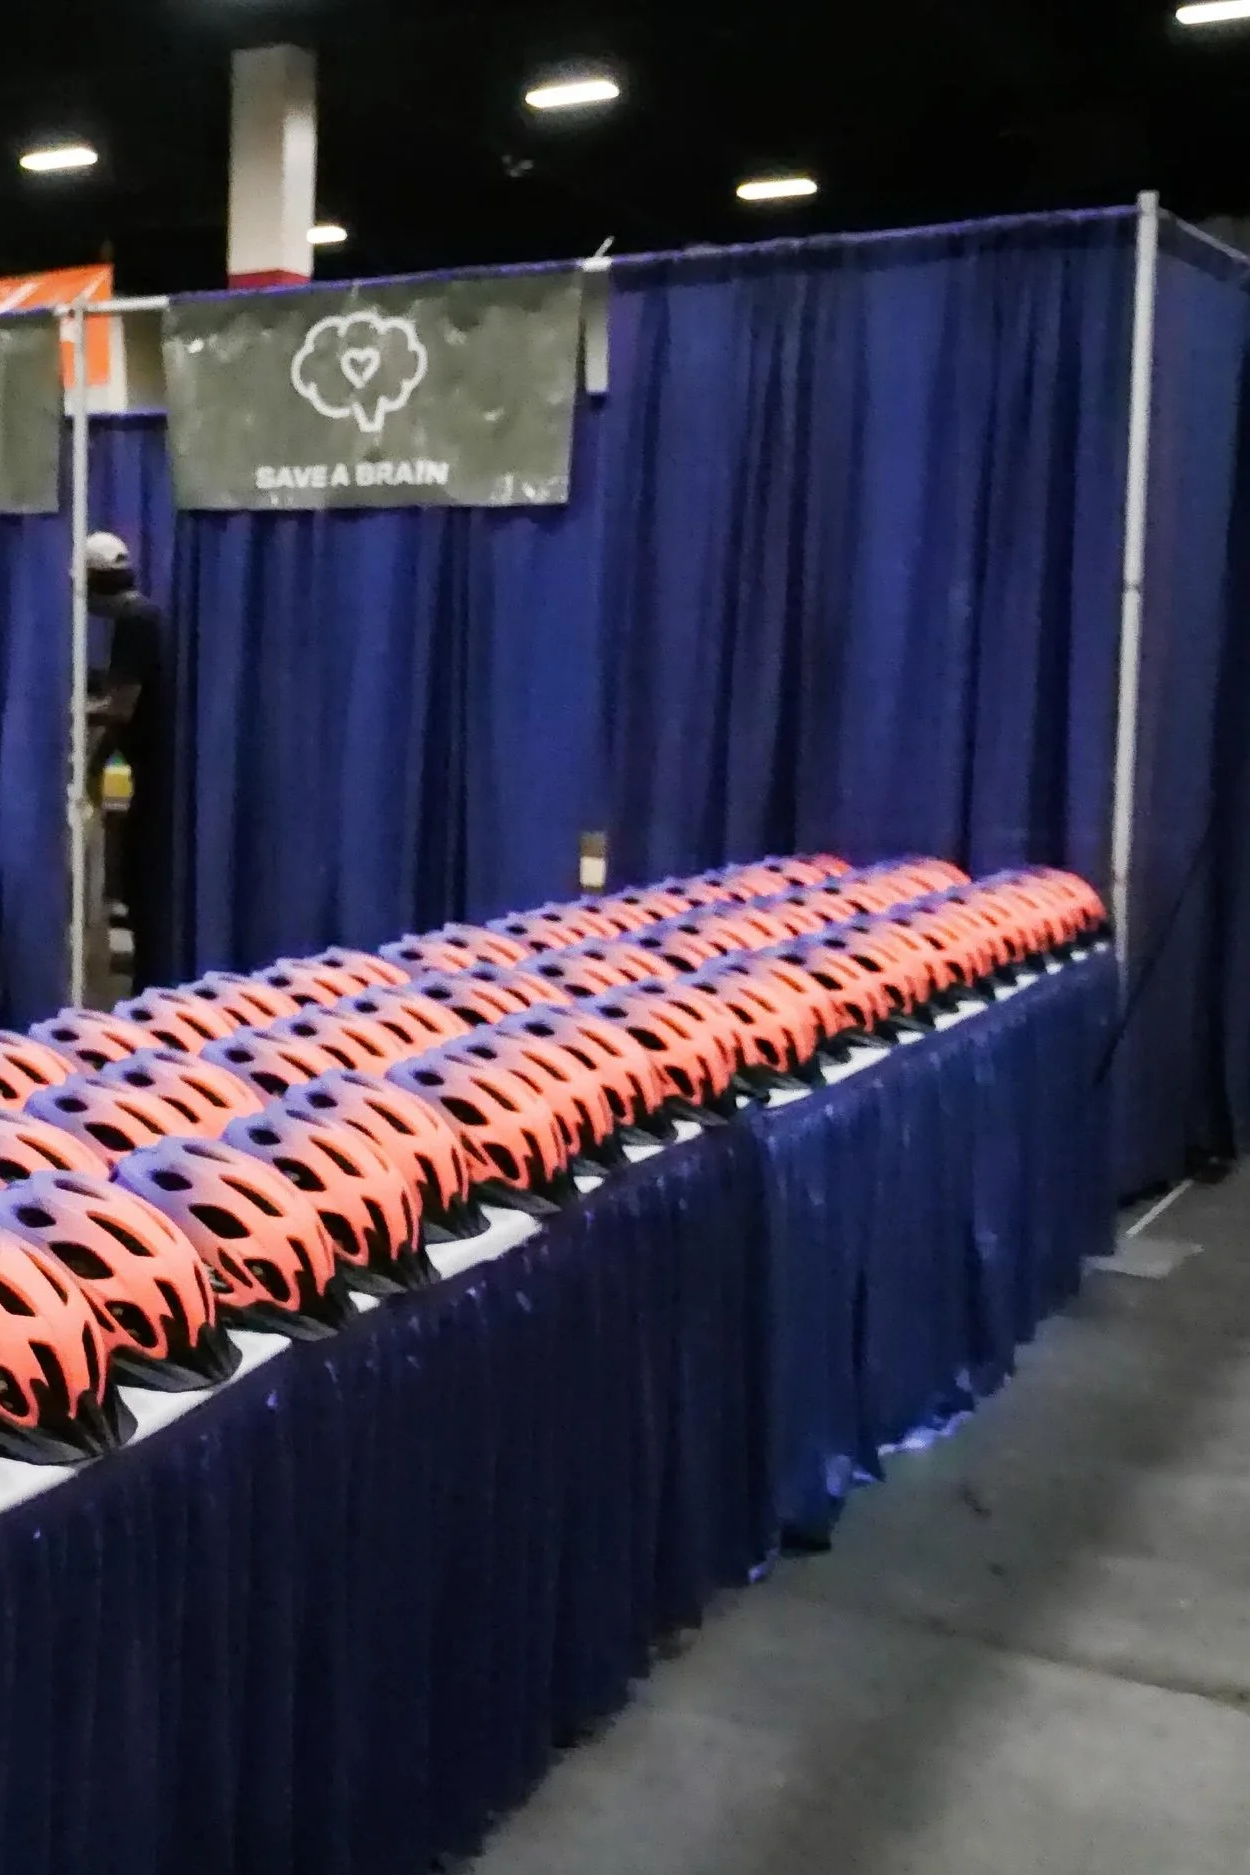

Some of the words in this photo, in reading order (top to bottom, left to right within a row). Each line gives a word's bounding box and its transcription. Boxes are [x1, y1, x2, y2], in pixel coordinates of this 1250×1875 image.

[254, 465, 328, 489] SAVE
[330, 462, 350, 487] A
[354, 459, 450, 487] BRAIN
